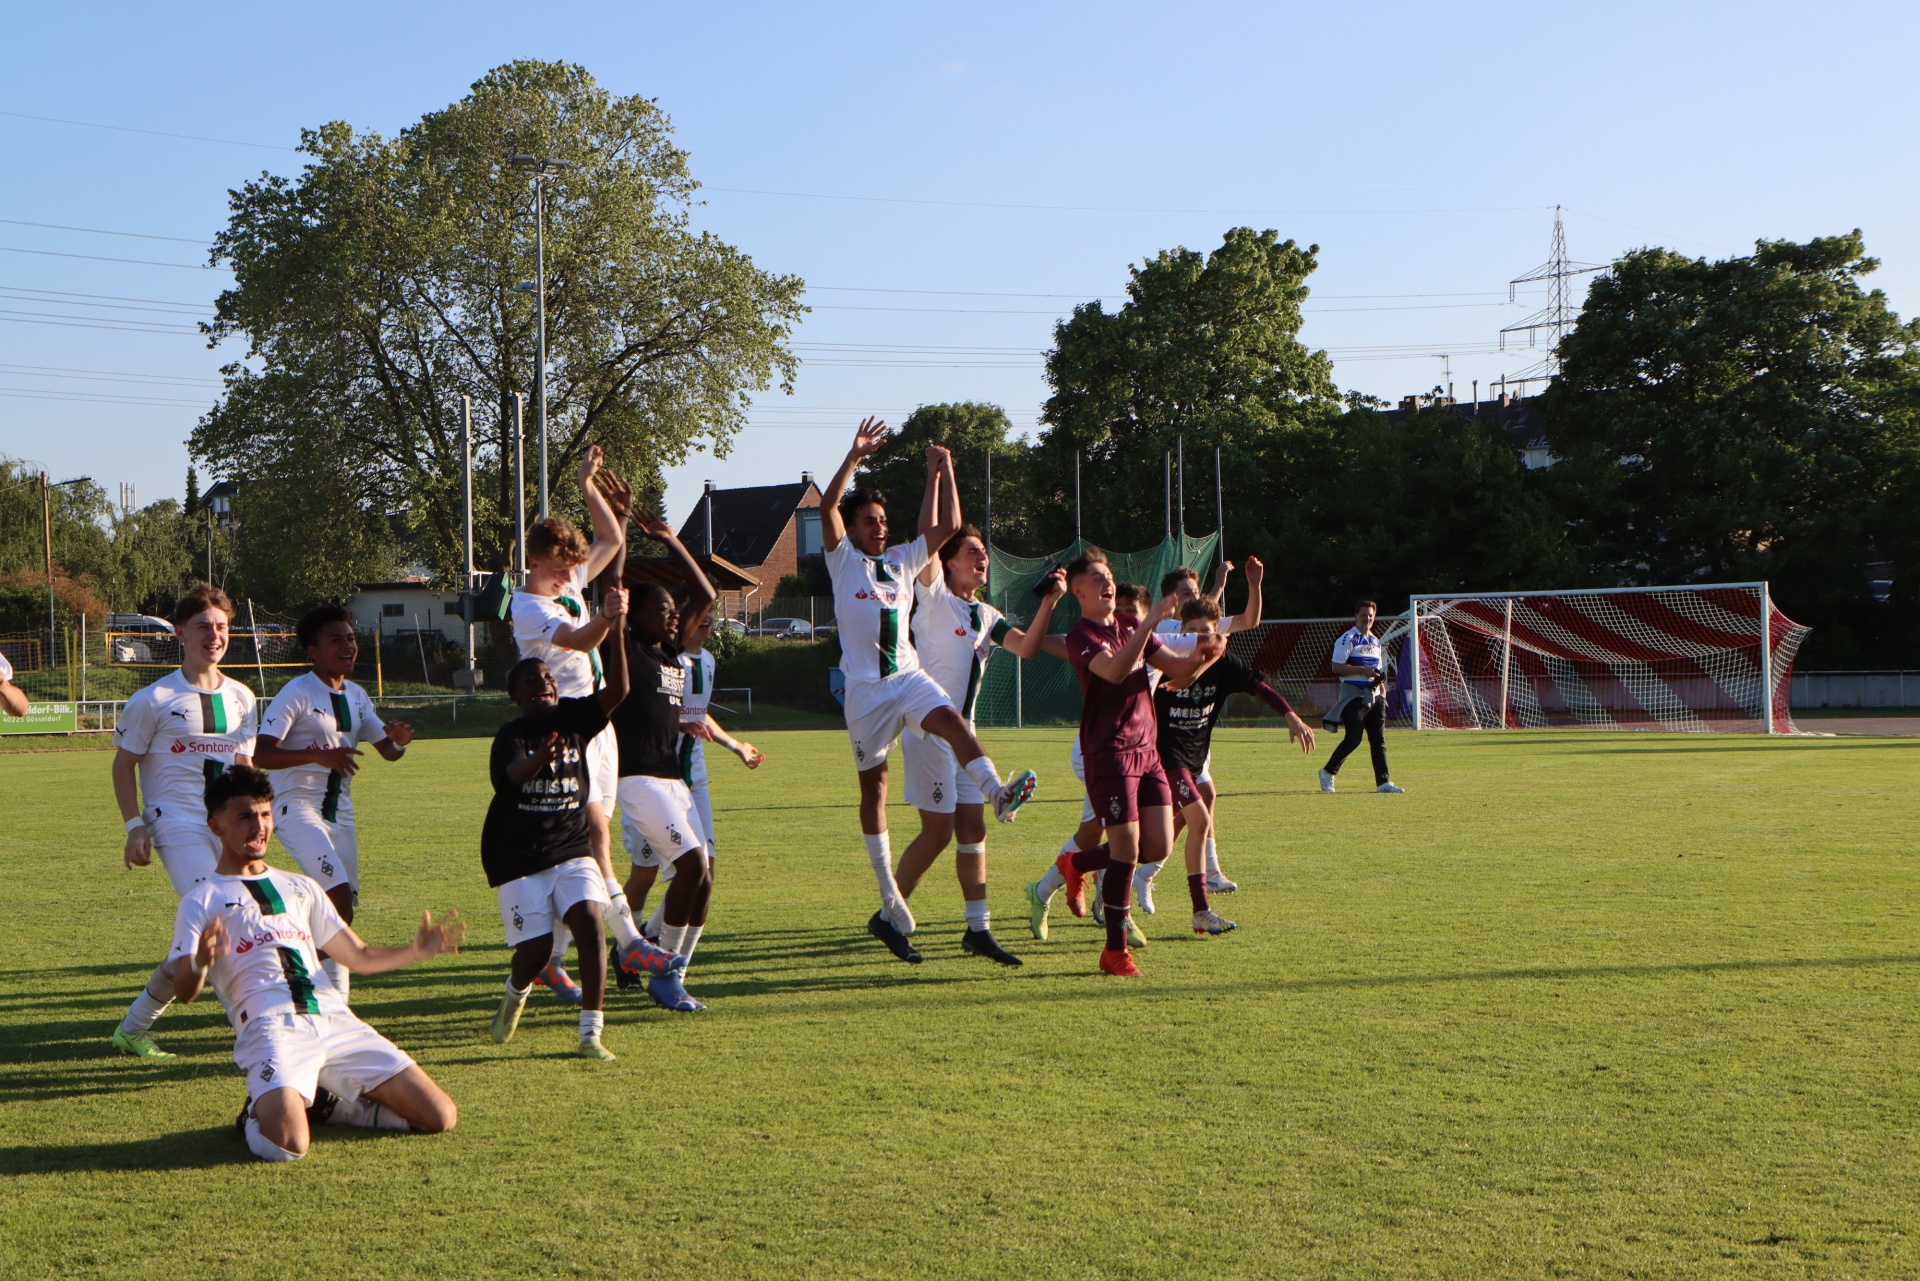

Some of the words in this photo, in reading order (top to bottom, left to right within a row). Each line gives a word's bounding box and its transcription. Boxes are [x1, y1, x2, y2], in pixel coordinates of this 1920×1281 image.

[1176, 688, 1190, 698] 22
[3, 704, 73, 715] ldorf-Bilk.
[26, 715, 61, 723] Düsseldorf
